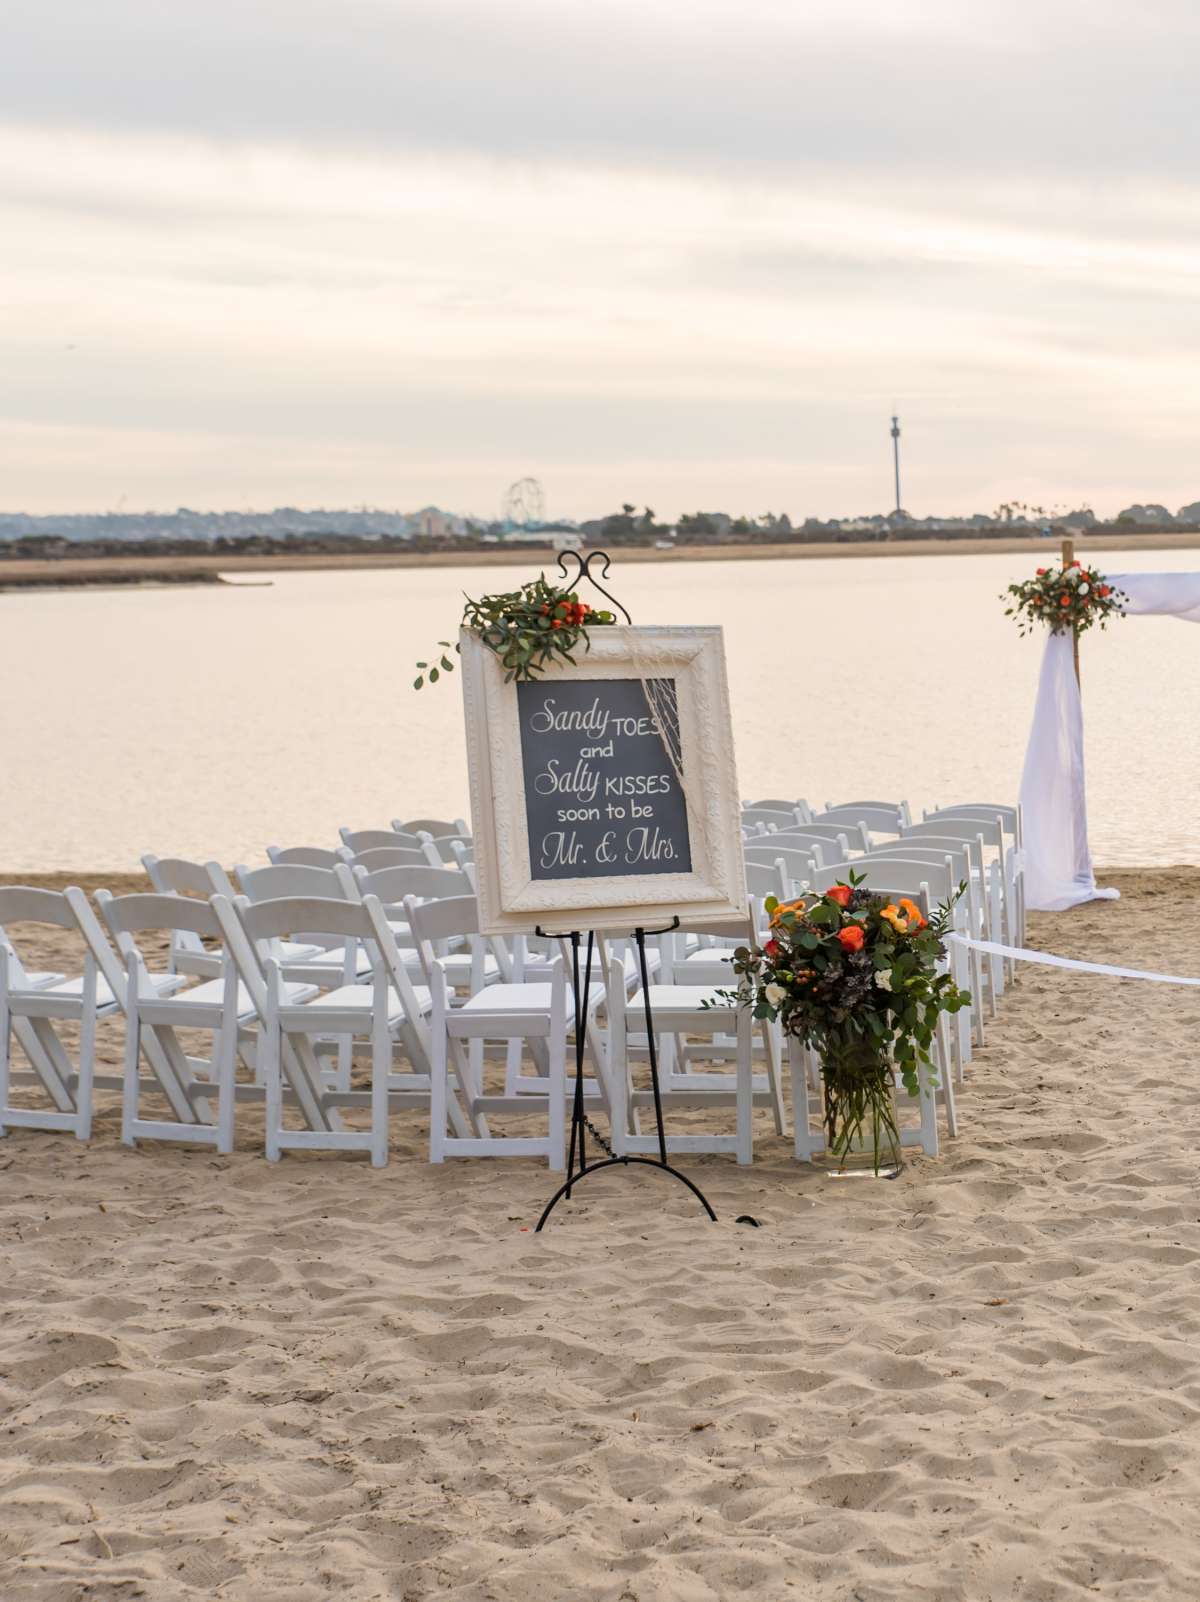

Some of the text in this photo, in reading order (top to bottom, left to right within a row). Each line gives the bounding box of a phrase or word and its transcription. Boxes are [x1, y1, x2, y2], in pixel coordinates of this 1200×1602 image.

[530, 697, 610, 740] Sandy
[580, 740, 614, 759] and
[534, 759, 671, 802] Salty KISSES
[557, 799, 654, 822] soon to be
[540, 826, 679, 869] Mr. & Mrs.
